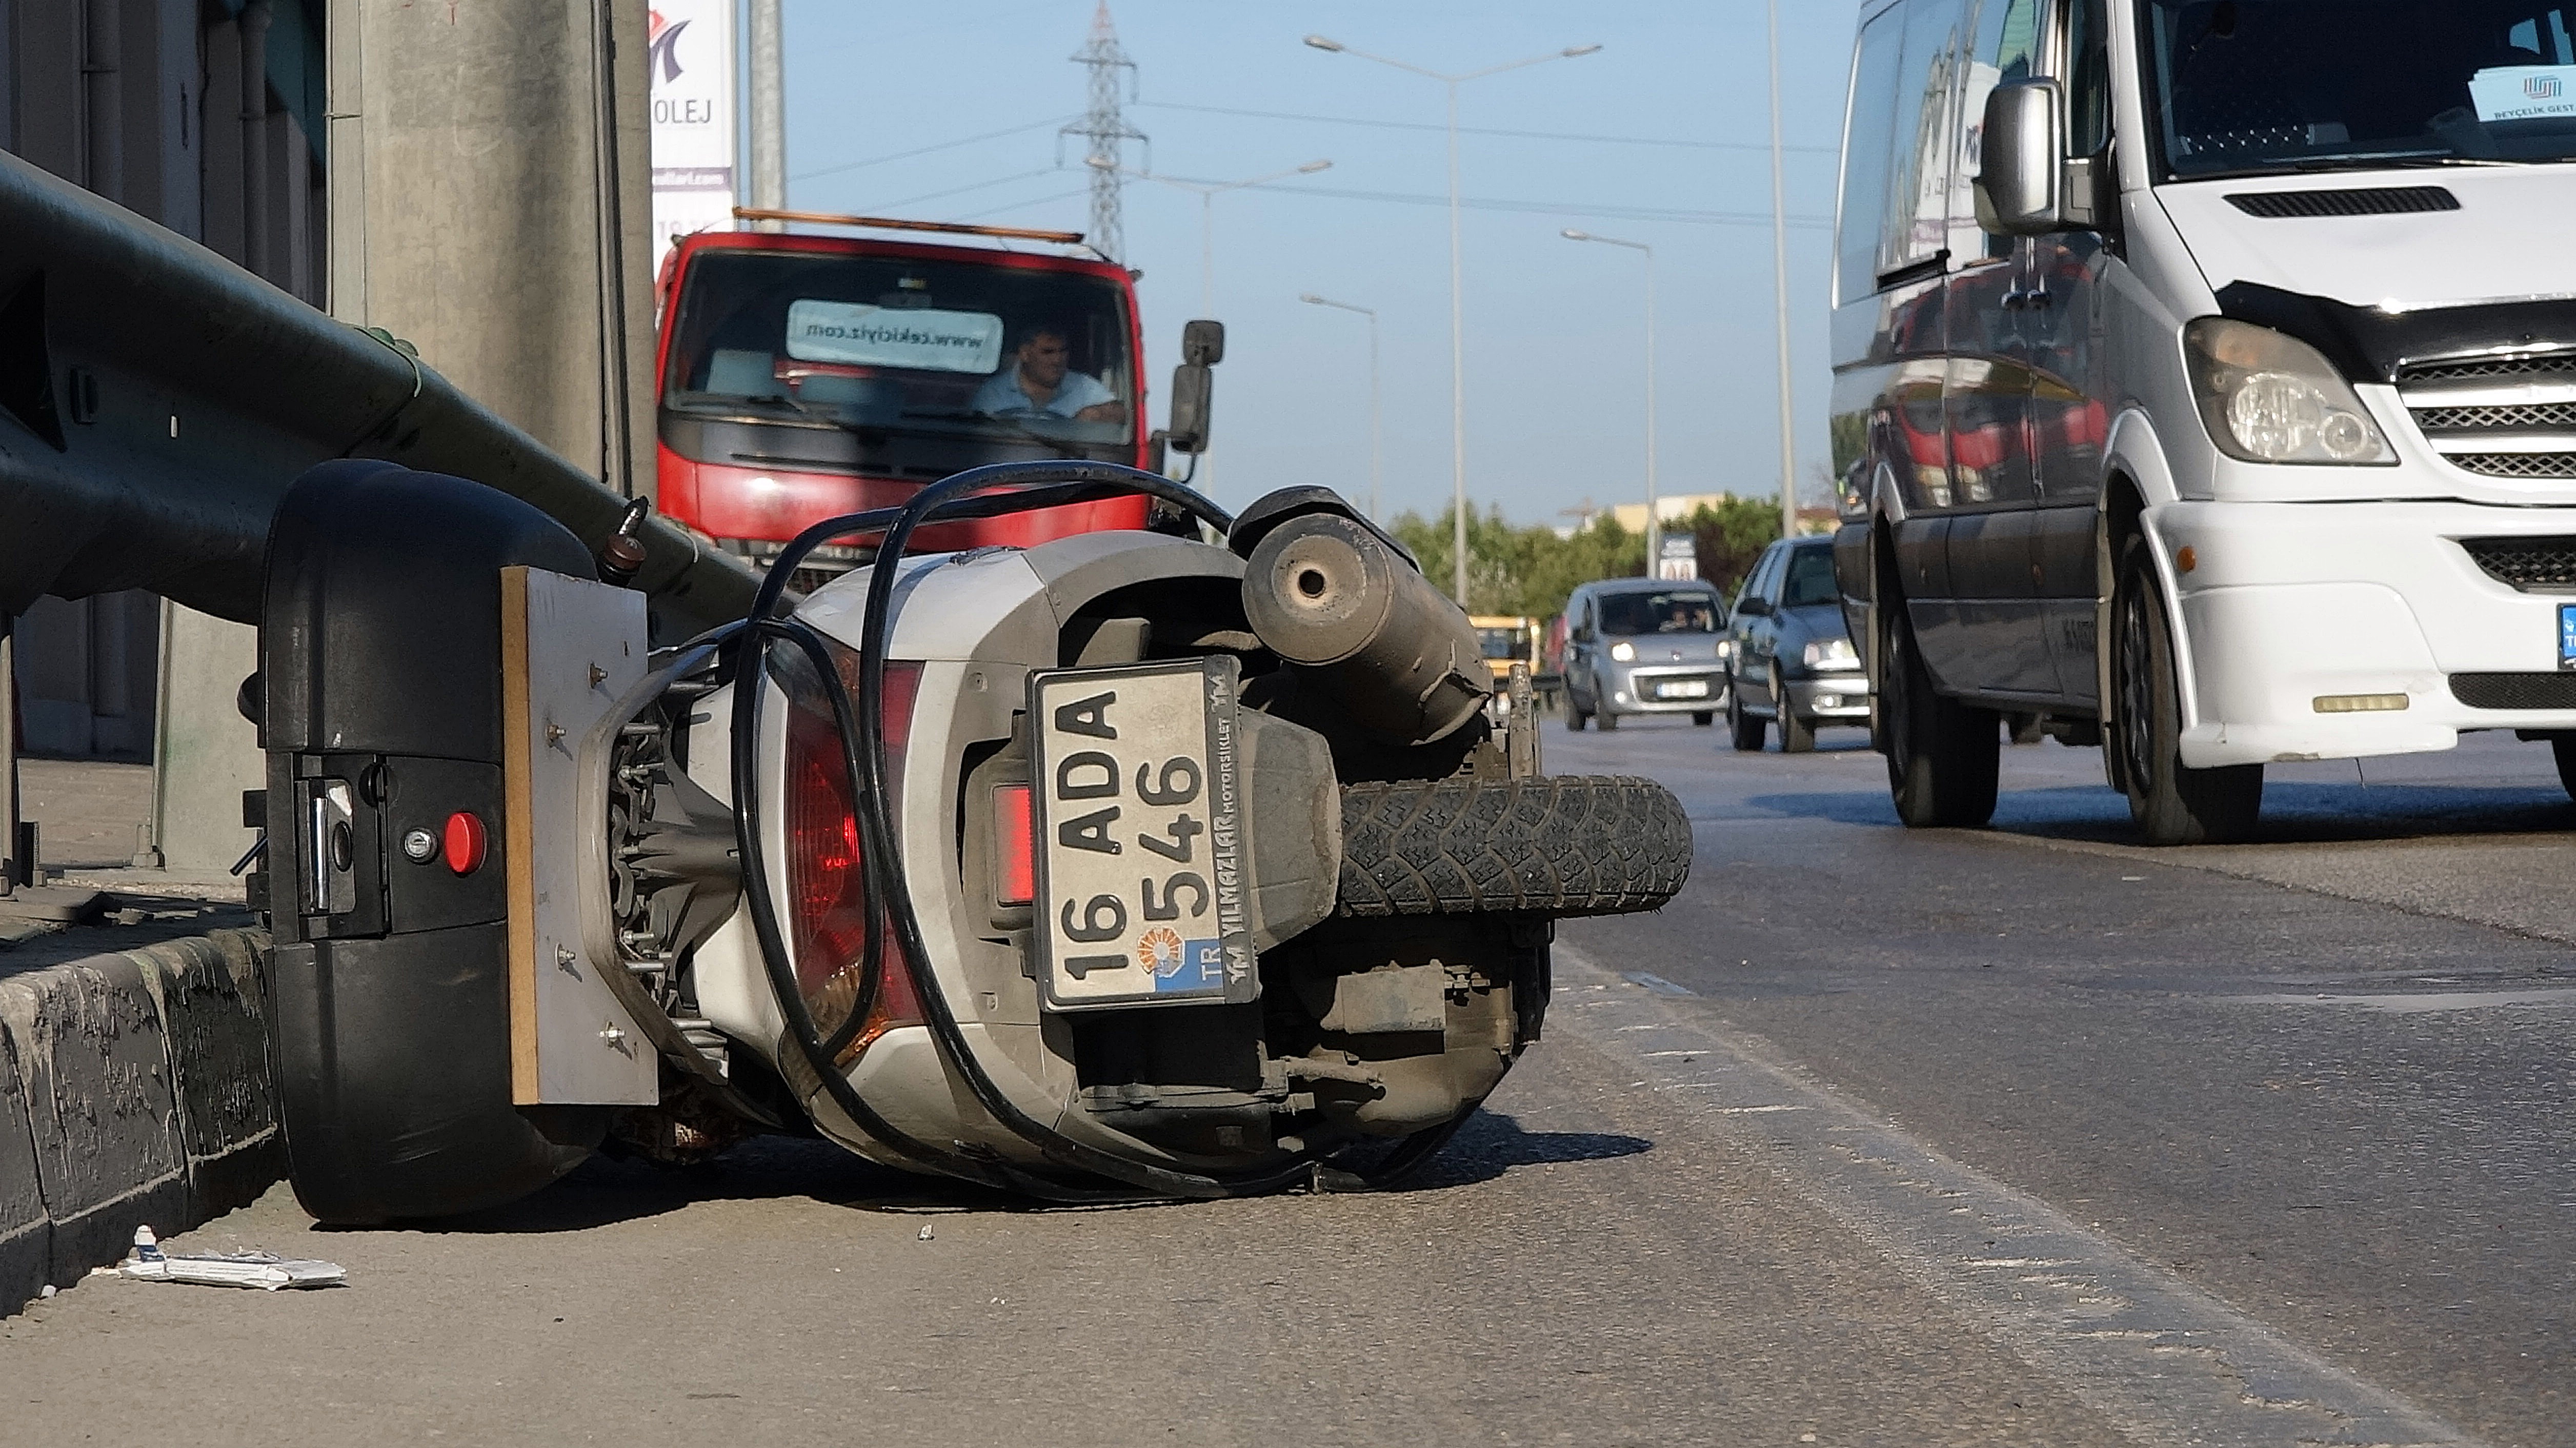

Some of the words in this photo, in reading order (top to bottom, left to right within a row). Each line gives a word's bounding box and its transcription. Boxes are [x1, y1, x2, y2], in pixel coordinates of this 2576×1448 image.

[1055, 691, 1122, 855] ADA
[1136, 756, 1210, 921] 546
[1214, 816, 1245, 937] YILMAZLAR
[1061, 894, 1129, 980] 16
[1201, 946, 1221, 980] TR
